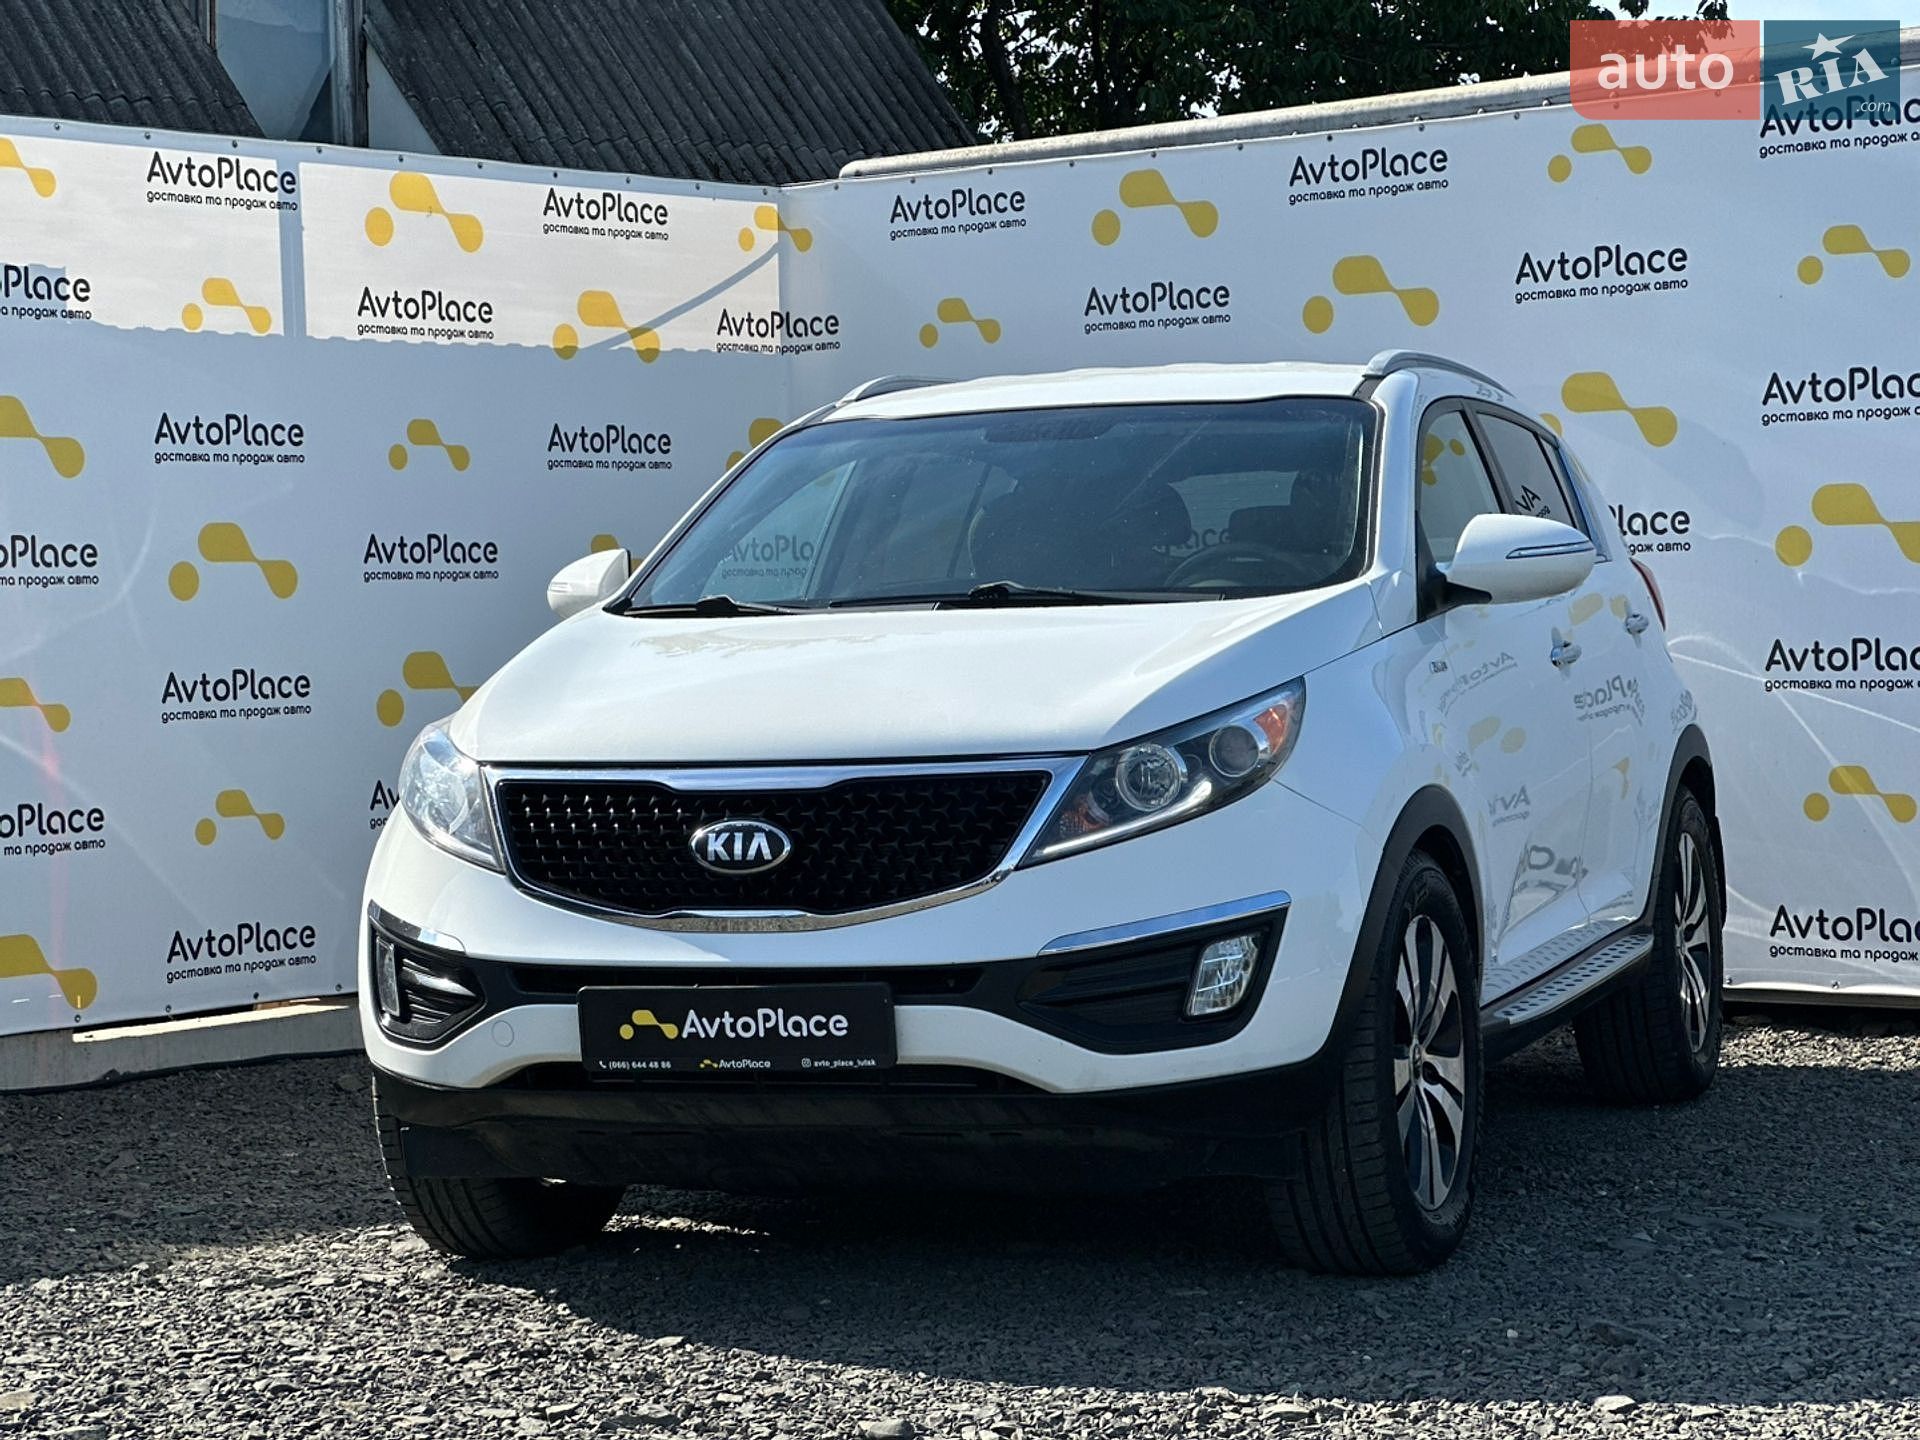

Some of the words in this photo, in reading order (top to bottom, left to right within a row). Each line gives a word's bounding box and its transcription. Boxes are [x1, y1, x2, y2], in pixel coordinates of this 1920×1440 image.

[1759, 94, 1920, 139] AvtoPlac
[1829, 137, 1850, 149] та
[147, 151, 297, 194] AvtoPlace
[1288, 147, 1448, 187] AvtoPlace
[1347, 187, 1366, 197] та
[1416, 178, 1448, 190] авто
[205, 195, 222, 205] та
[268, 198, 297, 211] авто
[543, 187, 668, 225] AvtoPlace
[890, 188, 1025, 223] AvtoPlace
[591, 226, 606, 236] та
[644, 230, 668, 240] авто
[940, 224, 955, 234] та
[998, 218, 1026, 228] авто
[1515, 244, 1688, 285] AvtoPlace
[0, 264, 91, 303] Place
[1579, 285, 1598, 296] та
[1653, 278, 1688, 290] авто
[357, 286, 493, 324] AvtoPlace
[1084, 281, 1230, 316] AvtoPlace
[61, 308, 92, 320] авто
[717, 308, 839, 338] AvtoPlace
[1138, 318, 1155, 328] та
[1200, 313, 1231, 324] авто
[410, 326, 425, 336] та
[467, 329, 494, 339] авто
[1761, 366, 1920, 406] AvtoPlac
[1832, 409, 1853, 420] та
[154, 412, 304, 447] AvtoPlace
[547, 423, 672, 454] AvtoPlace
[212, 452, 229, 462] та
[276, 453, 305, 463] авто
[595, 459, 609, 469] та
[647, 460, 672, 469] авто
[363, 533, 498, 564] AvtoPlace
[1656, 541, 1691, 552] авто
[67, 574, 99, 585] авто
[415, 570, 430, 579] та
[472, 570, 499, 579] авто
[161, 668, 311, 704] AvtoPlace
[1835, 679, 1856, 689] та
[219, 708, 236, 718] та
[282, 704, 311, 715] авто
[0, 803, 105, 838] oPlace
[4, 844, 22, 856] та
[73, 838, 106, 850] авто
[706, 831, 773, 862] KIA
[1769, 904, 1920, 944] AvtoPla
[167, 921, 316, 964] AvtoPlace
[1839, 948, 1861, 958] та
[224, 962, 241, 973] та
[287, 954, 316, 966] авто
[681, 1007, 849, 1039] AvtoPlace
[719, 1058, 771, 1069] AvtoPlace
